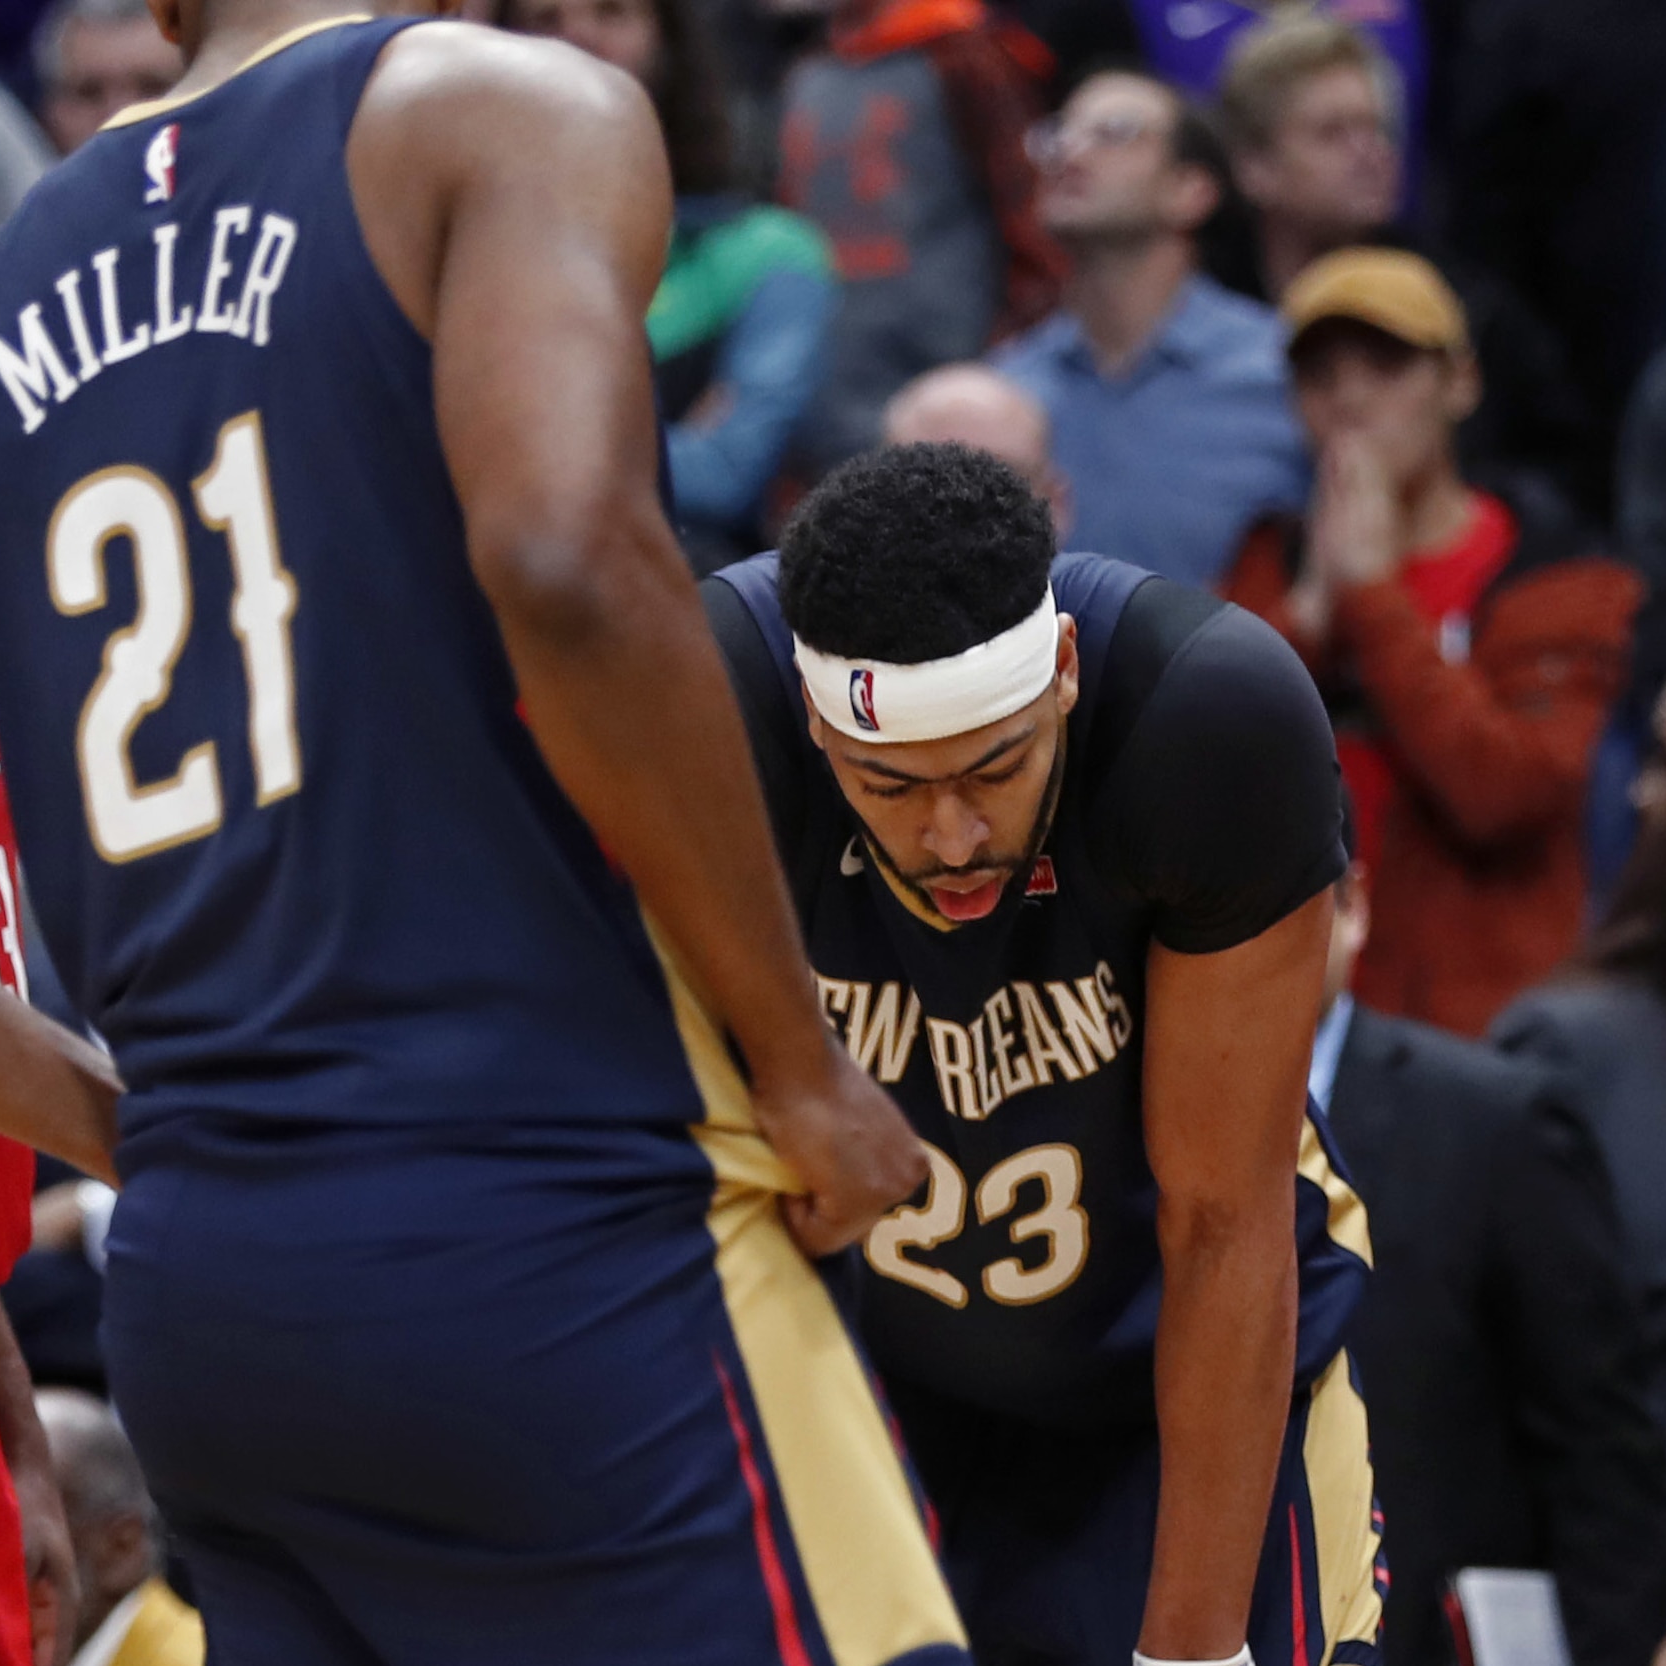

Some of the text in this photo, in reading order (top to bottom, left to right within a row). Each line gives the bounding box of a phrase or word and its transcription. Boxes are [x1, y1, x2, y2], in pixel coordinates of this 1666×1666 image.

[46, 409, 303, 864] 21
[926, 960, 1131, 1121] RLEANS
[863, 1142, 1090, 1310] 23
